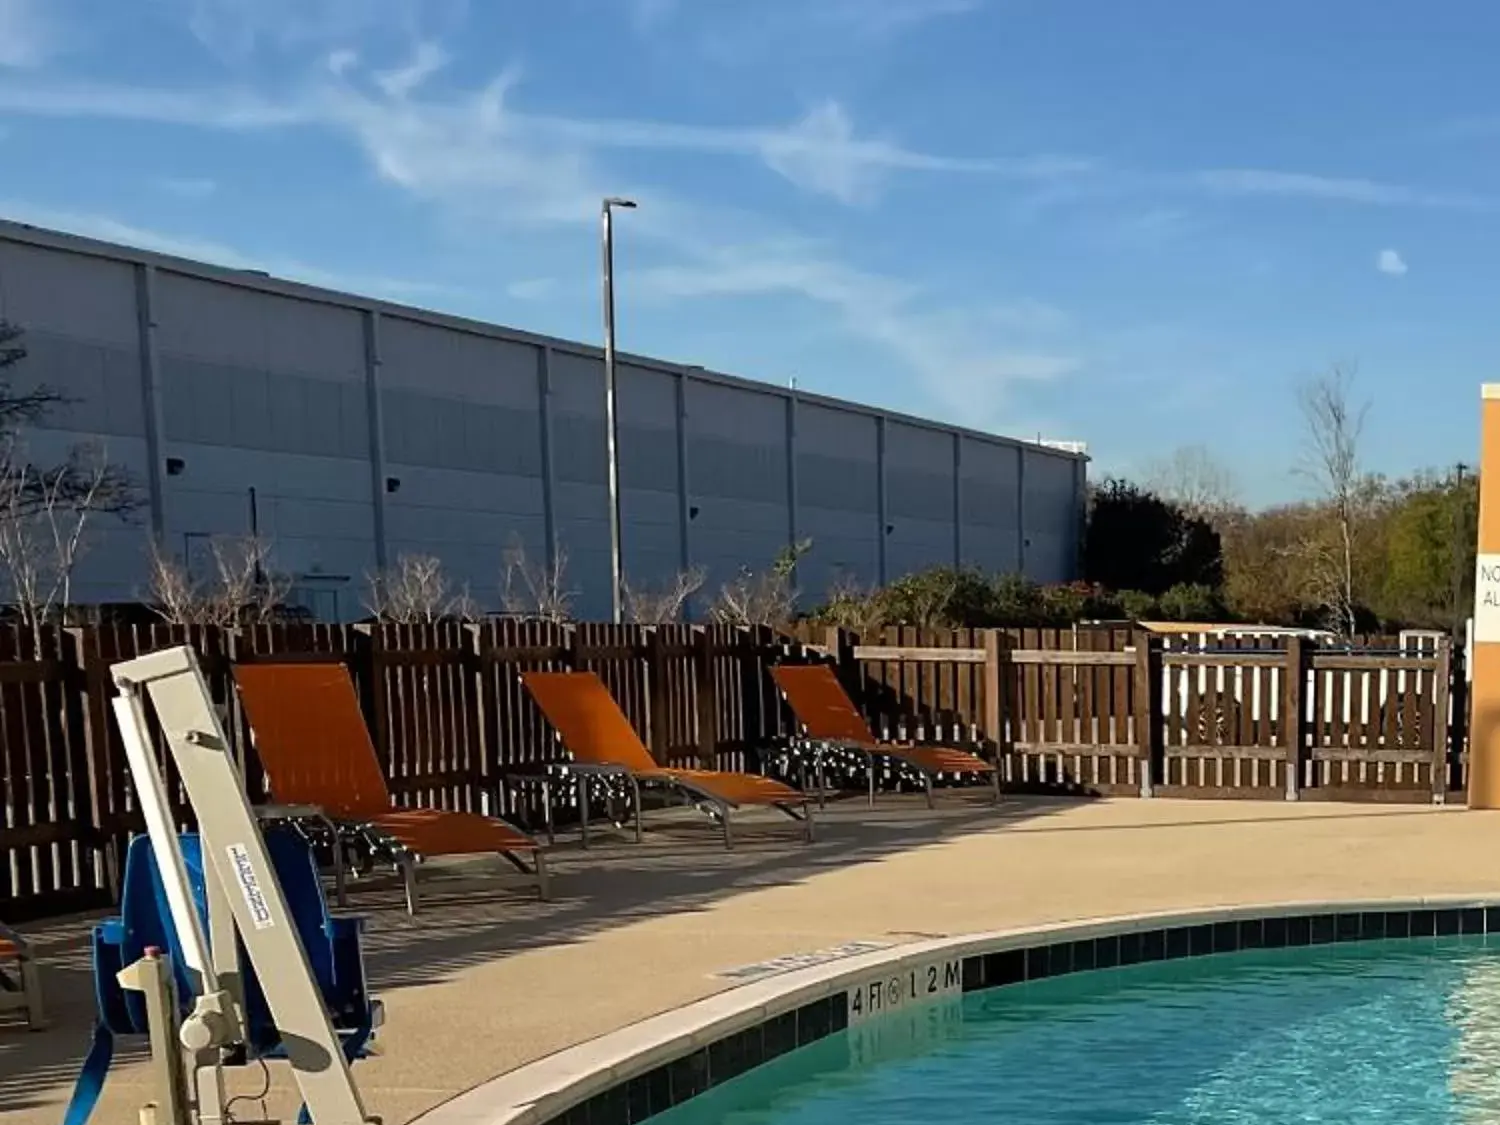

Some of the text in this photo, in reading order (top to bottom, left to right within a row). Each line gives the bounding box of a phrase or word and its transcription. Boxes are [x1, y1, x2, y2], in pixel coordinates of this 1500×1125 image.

[852, 987, 862, 1016] 4
[868, 981, 884, 1013] FT
[943, 959, 961, 989] M
